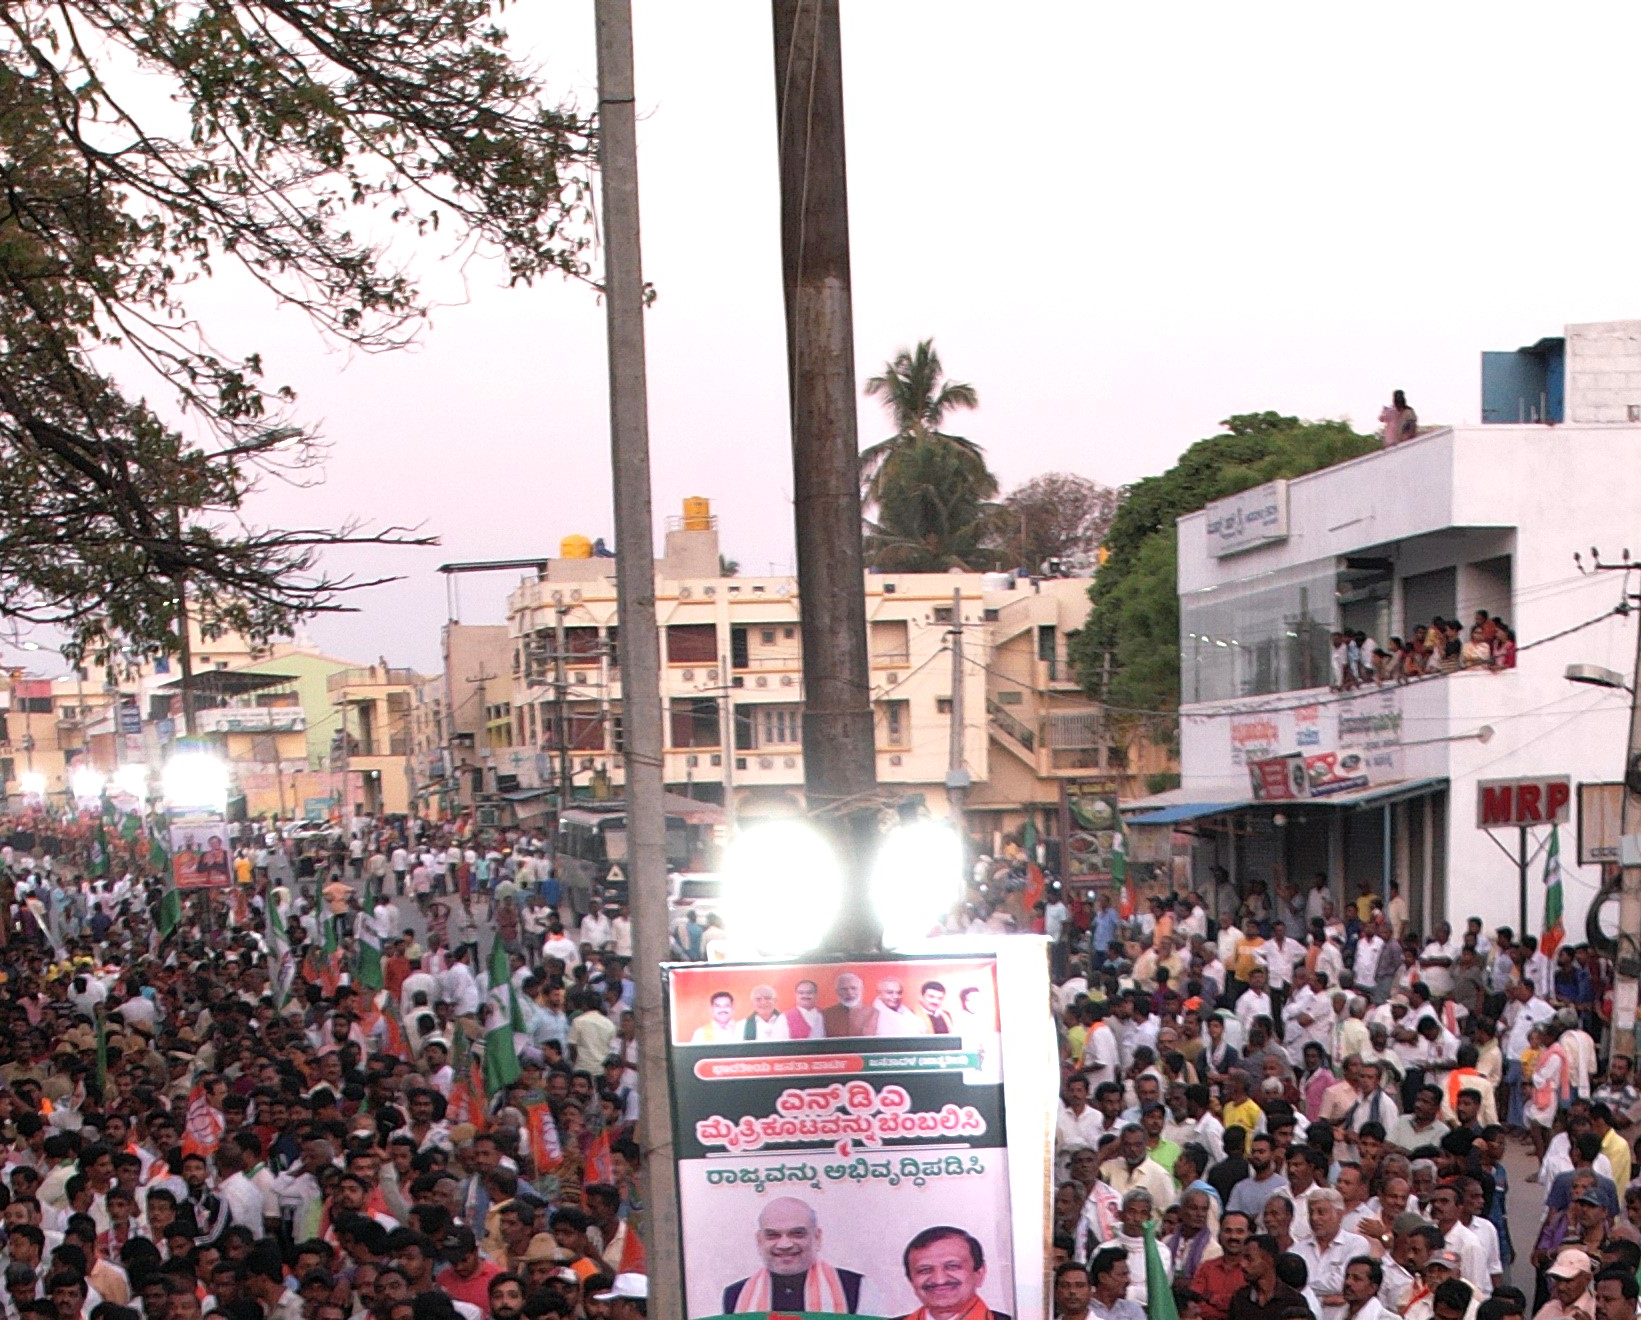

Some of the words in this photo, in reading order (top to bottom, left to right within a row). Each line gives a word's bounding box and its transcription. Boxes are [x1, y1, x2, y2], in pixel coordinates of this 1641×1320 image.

[1482, 782, 1570, 823] MRP
[779, 1086, 840, 1112] ಎನ್
[847, 1082, 874, 1110] ಡಿ
[878, 1087, 907, 1109] ಎ
[700, 1114, 877, 1147] ಮೈತ್ರಿಕೂಟವನ್ನು
[878, 1108, 982, 1134] ಬೆಂಬಲಿಸಿ
[705, 1162, 823, 1194] ರಾಜ್ಯವನ್ನು
[823, 1155, 986, 1187] ಅಭಿವೃದ್ಧಿಪಡಿಸಿ
